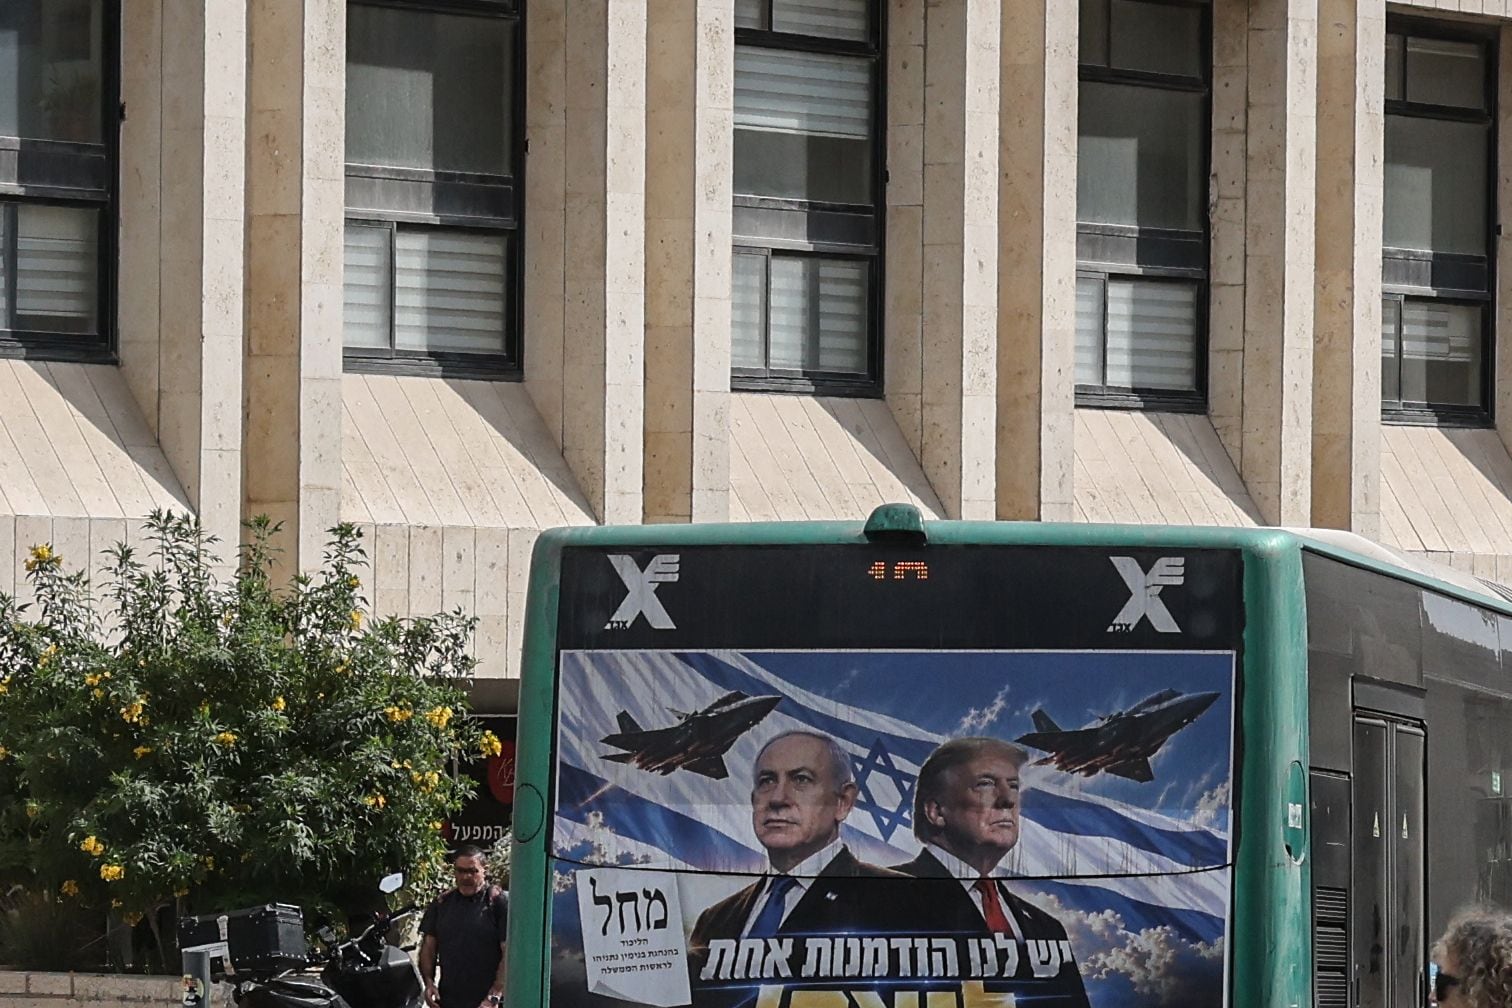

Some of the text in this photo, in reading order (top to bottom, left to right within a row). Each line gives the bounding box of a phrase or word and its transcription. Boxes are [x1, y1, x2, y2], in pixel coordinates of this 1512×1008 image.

[451, 822, 503, 841] המפעל
[589, 876, 668, 937] מחל
[619, 937, 649, 947] הליכוד
[592, 948, 679, 963] בהנהגת בנימין נתניהו
[700, 932, 1073, 981] יש לנו הזדמנות אחת
[601, 961, 673, 975] לראשות הממשלה
